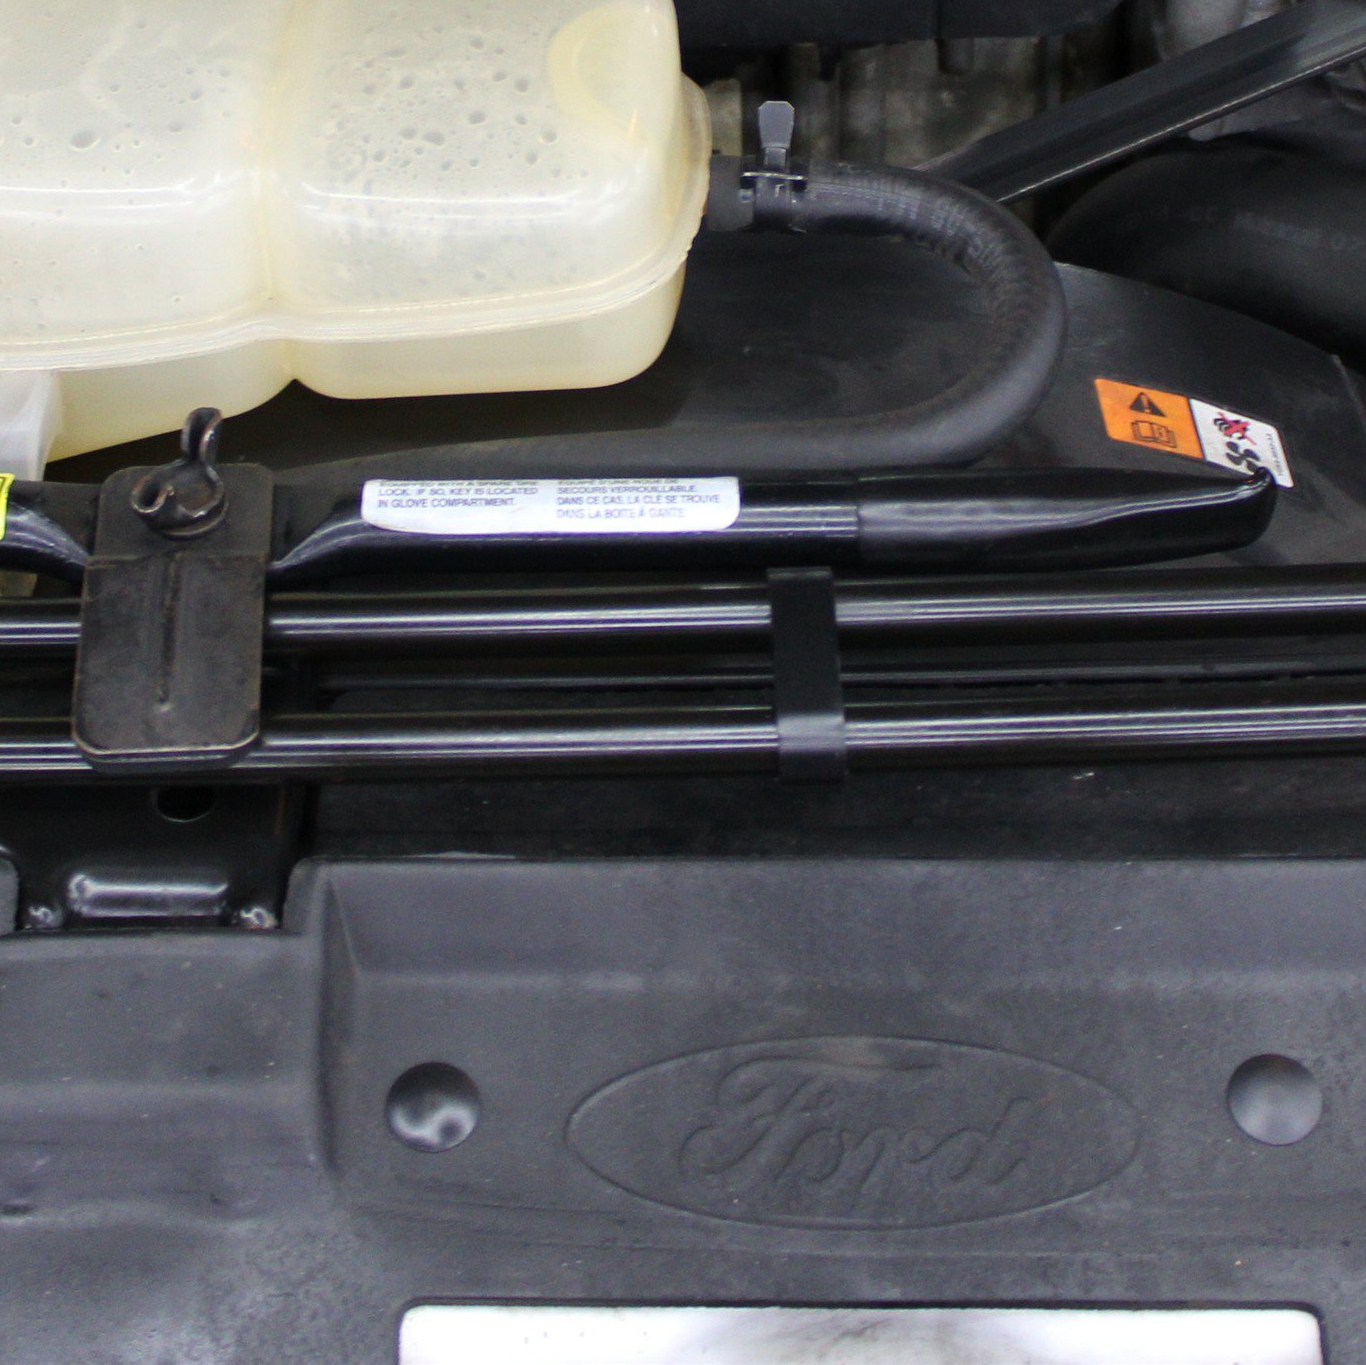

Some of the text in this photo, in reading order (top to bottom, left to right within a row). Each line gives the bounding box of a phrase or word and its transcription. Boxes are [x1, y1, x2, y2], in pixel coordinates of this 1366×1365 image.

[450, 487, 473, 495] KEY
[487, 486, 539, 496] LOCATED
[557, 485, 608, 495] SECOURS
[378, 498, 388, 508] IN
[391, 497, 428, 508] GLOVE
[556, 495, 584, 506] DANS
[680, 493, 720, 504] TROUVE
[676, 1054, 1037, 1195] Ford
